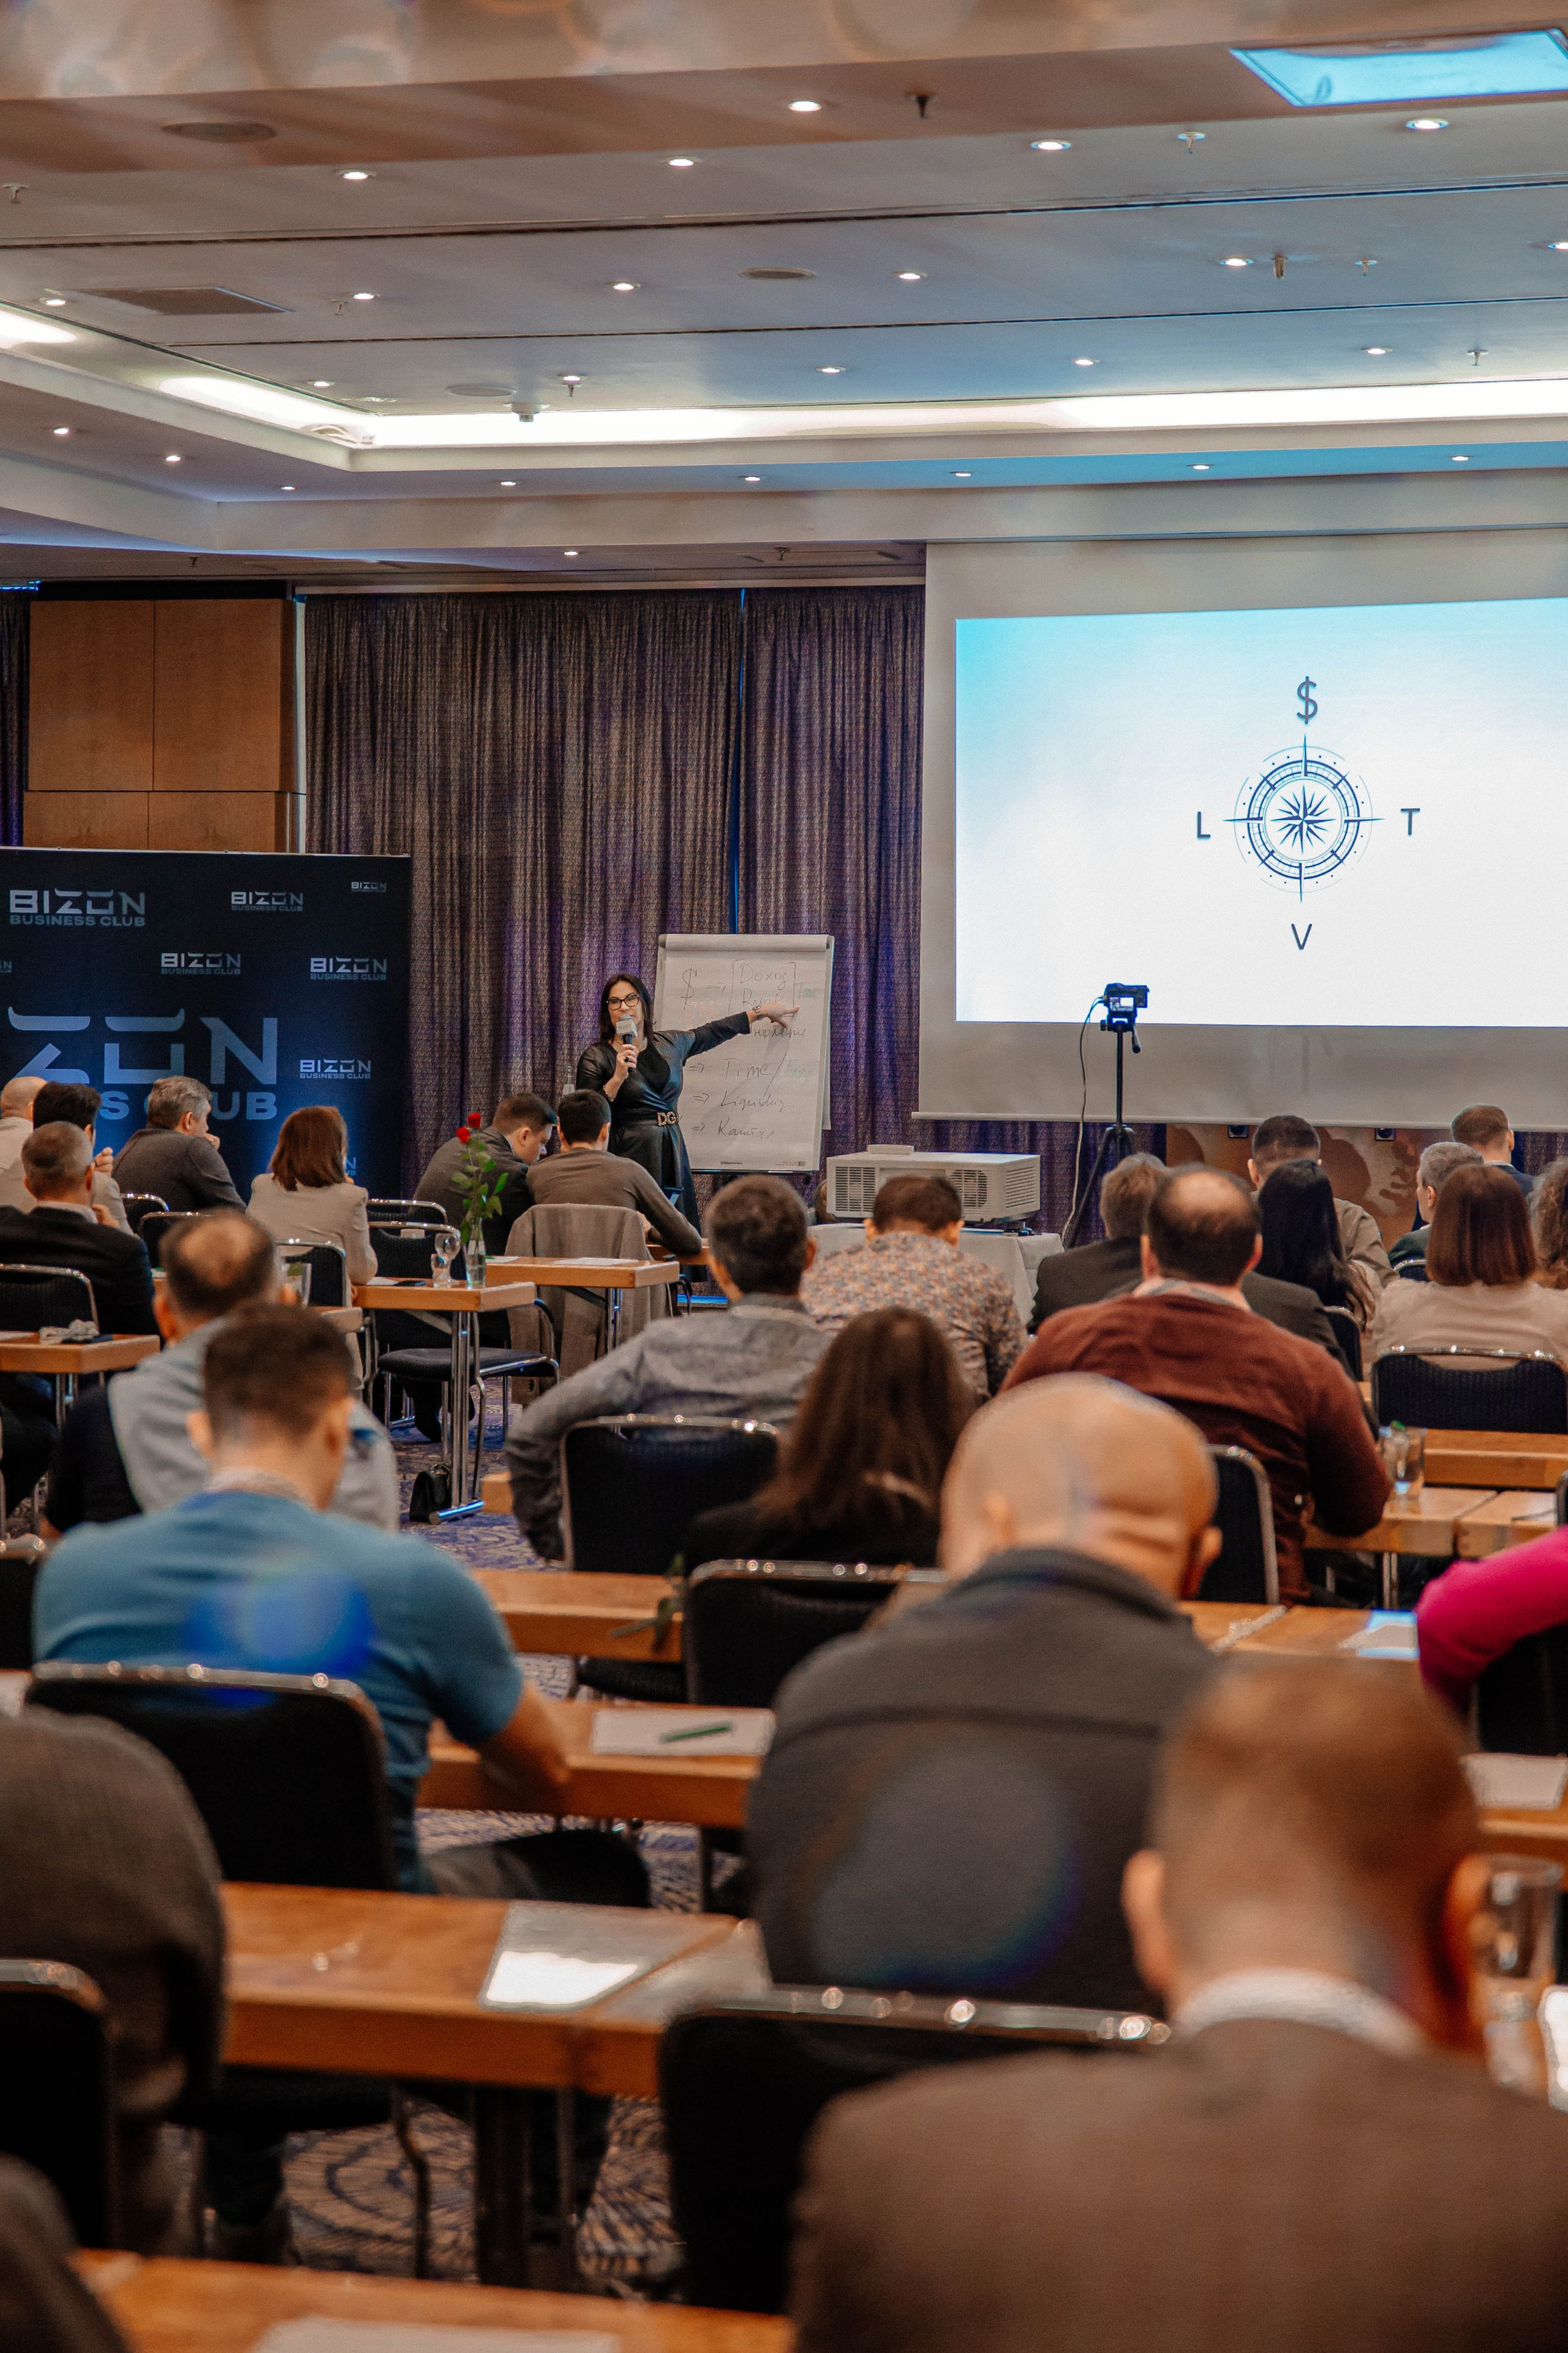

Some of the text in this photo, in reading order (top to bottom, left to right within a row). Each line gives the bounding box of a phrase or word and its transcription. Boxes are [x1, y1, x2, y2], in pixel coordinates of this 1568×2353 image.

[1297, 676, 1317, 724] $
[1197, 812, 1211, 839] L
[1401, 807, 1420, 836] T
[9, 888, 145, 915] BIZON
[231, 891, 303, 905] BIZON
[10, 915, 146, 927] BUSINESS CLUB
[1291, 923, 1312, 950] V
[161, 952, 241, 967] BIZON
[310, 956, 387, 973] BIZON
[300, 1059, 371, 1073] BIZON
